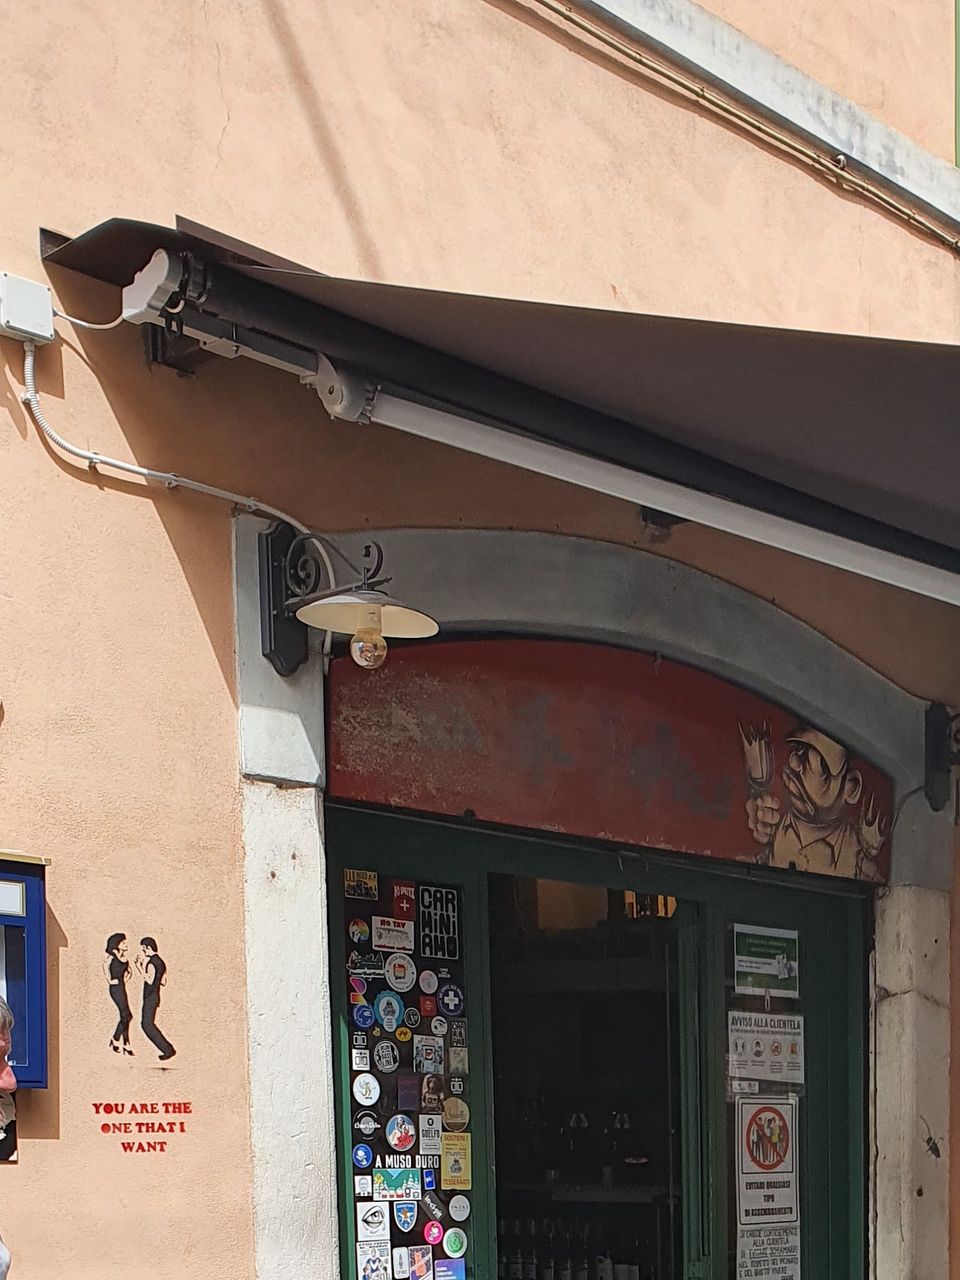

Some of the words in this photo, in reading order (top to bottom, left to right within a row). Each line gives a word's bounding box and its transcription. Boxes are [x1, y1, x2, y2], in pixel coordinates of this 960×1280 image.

[420, 887, 456, 913] CAR
[380, 918, 391, 927] NO
[392, 920, 406, 929] TAV
[731, 1015, 753, 1027] AVVISO
[753, 1017, 769, 1029] ALLA
[769, 1018, 801, 1030] CLIENTELA
[92, 1102, 125, 1115] YOU
[128, 1102, 160, 1114] ARE
[162, 1102, 192, 1114] THE
[101, 1122, 133, 1133] ONE
[135, 1122, 177, 1133] THAT
[179, 1121, 186, 1133] I
[121, 1141, 168, 1153] WANT
[375, 1154, 383, 1168] A
[385, 1154, 412, 1168] MUSO
[415, 1155, 440, 1169] DURO
